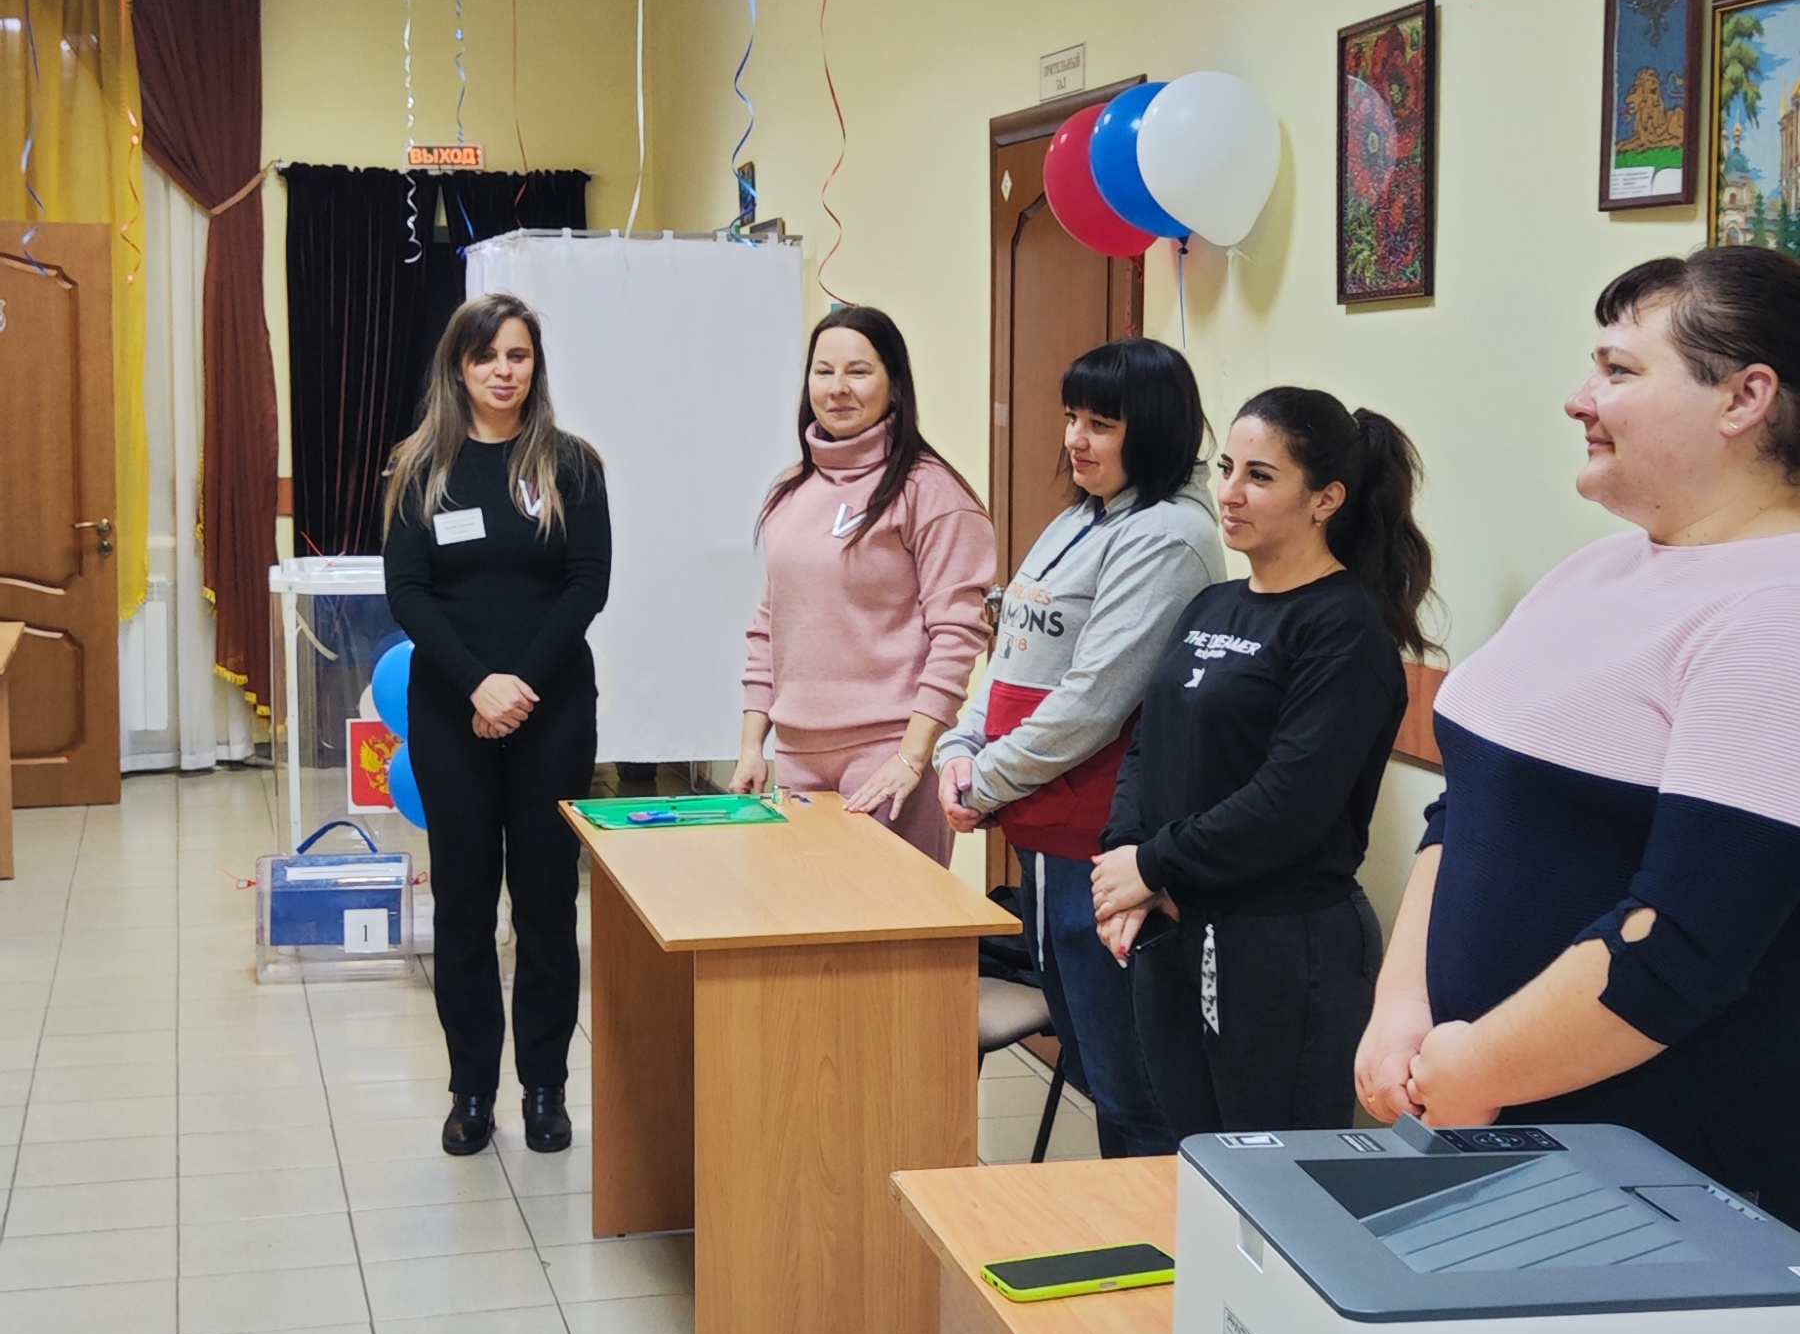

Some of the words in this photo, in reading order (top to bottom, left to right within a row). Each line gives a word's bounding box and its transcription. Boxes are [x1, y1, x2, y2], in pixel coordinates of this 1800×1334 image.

[410, 148, 476, 164] ВЫХОД
[1183, 630, 1211, 648] THE
[362, 924, 368, 942] 1
